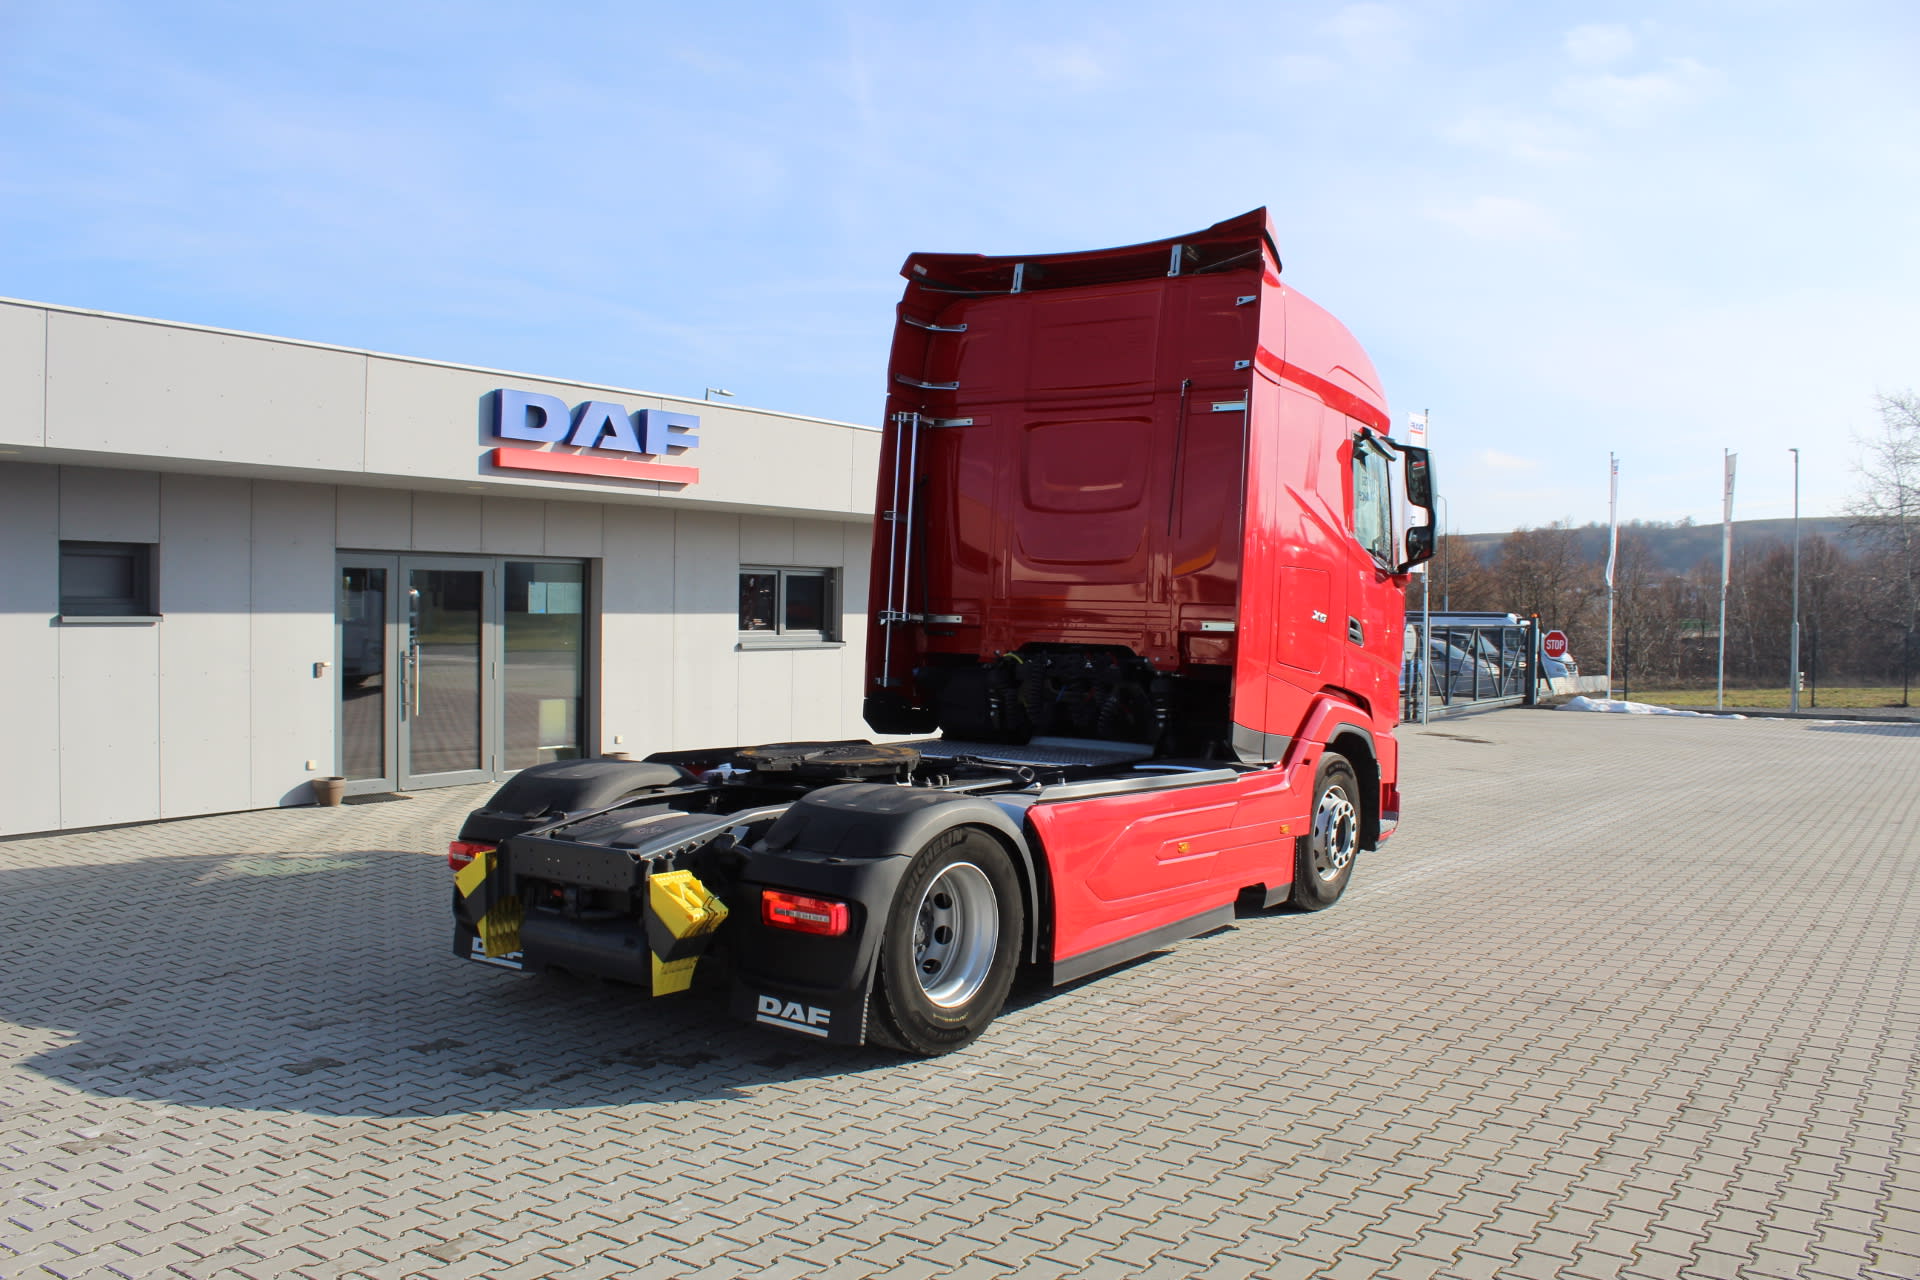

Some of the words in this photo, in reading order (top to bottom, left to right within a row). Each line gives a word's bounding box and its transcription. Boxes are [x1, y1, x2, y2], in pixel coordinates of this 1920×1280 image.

[493, 388, 700, 455] DAF
[1311, 609, 1328, 624] XG
[1546, 639, 1565, 650] STOP
[903, 828, 963, 904] MICHELIN
[757, 994, 831, 1026] DAF
